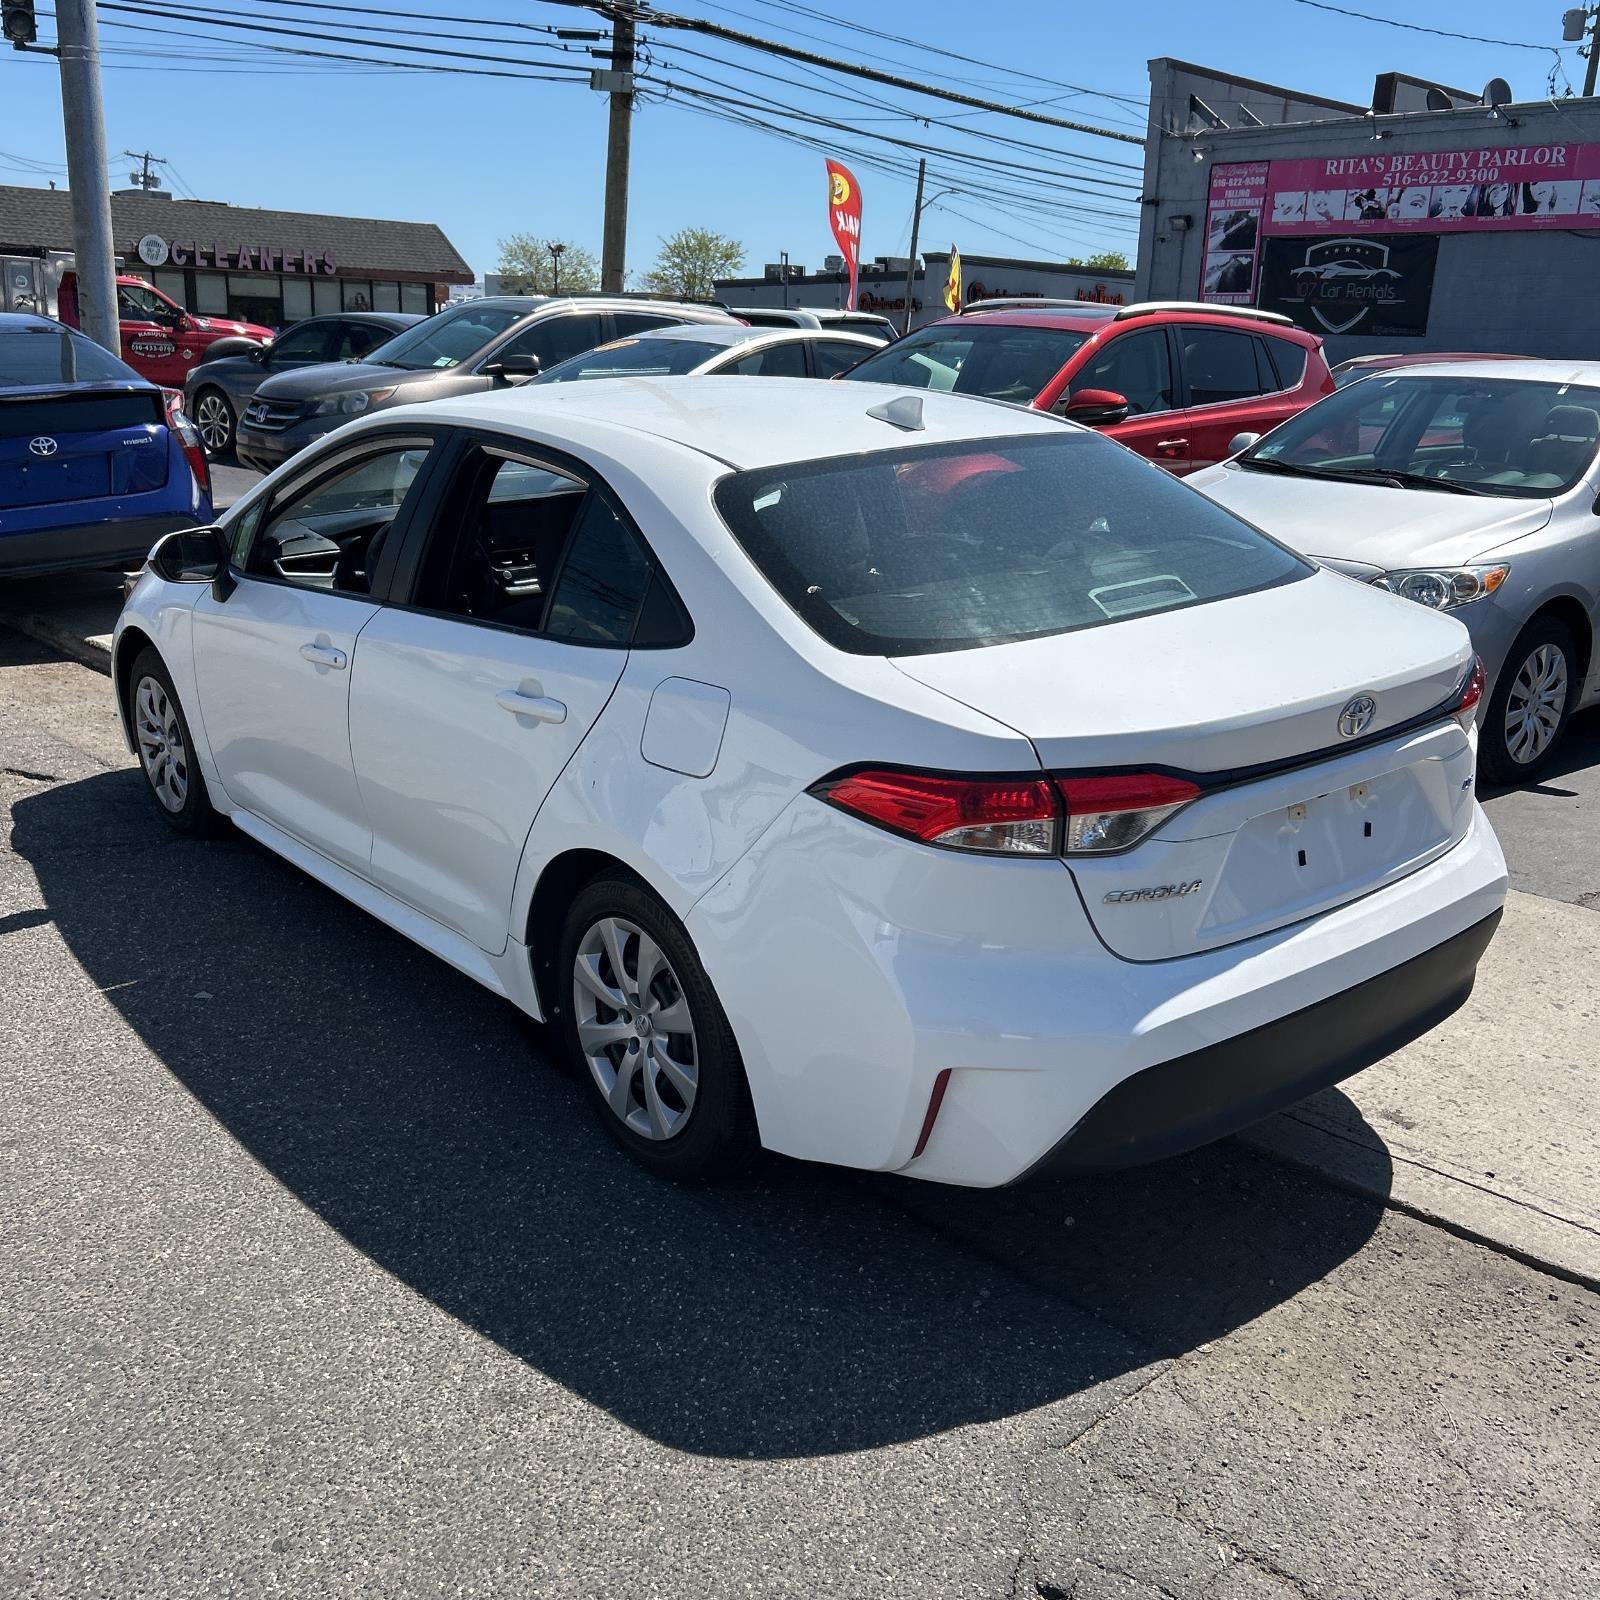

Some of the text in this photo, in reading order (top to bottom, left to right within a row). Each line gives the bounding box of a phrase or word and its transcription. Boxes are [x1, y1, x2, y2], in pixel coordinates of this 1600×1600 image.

[1325, 146, 1567, 175] RITA'S BEAUTY PARLOR
[1382, 167, 1499, 187] 516-622-9300
[171, 240, 337, 274] CLEANERS
[1320, 281, 1342, 298] Car
[1346, 282, 1396, 299] Rentals
[1103, 879, 1203, 904] COROLLA
